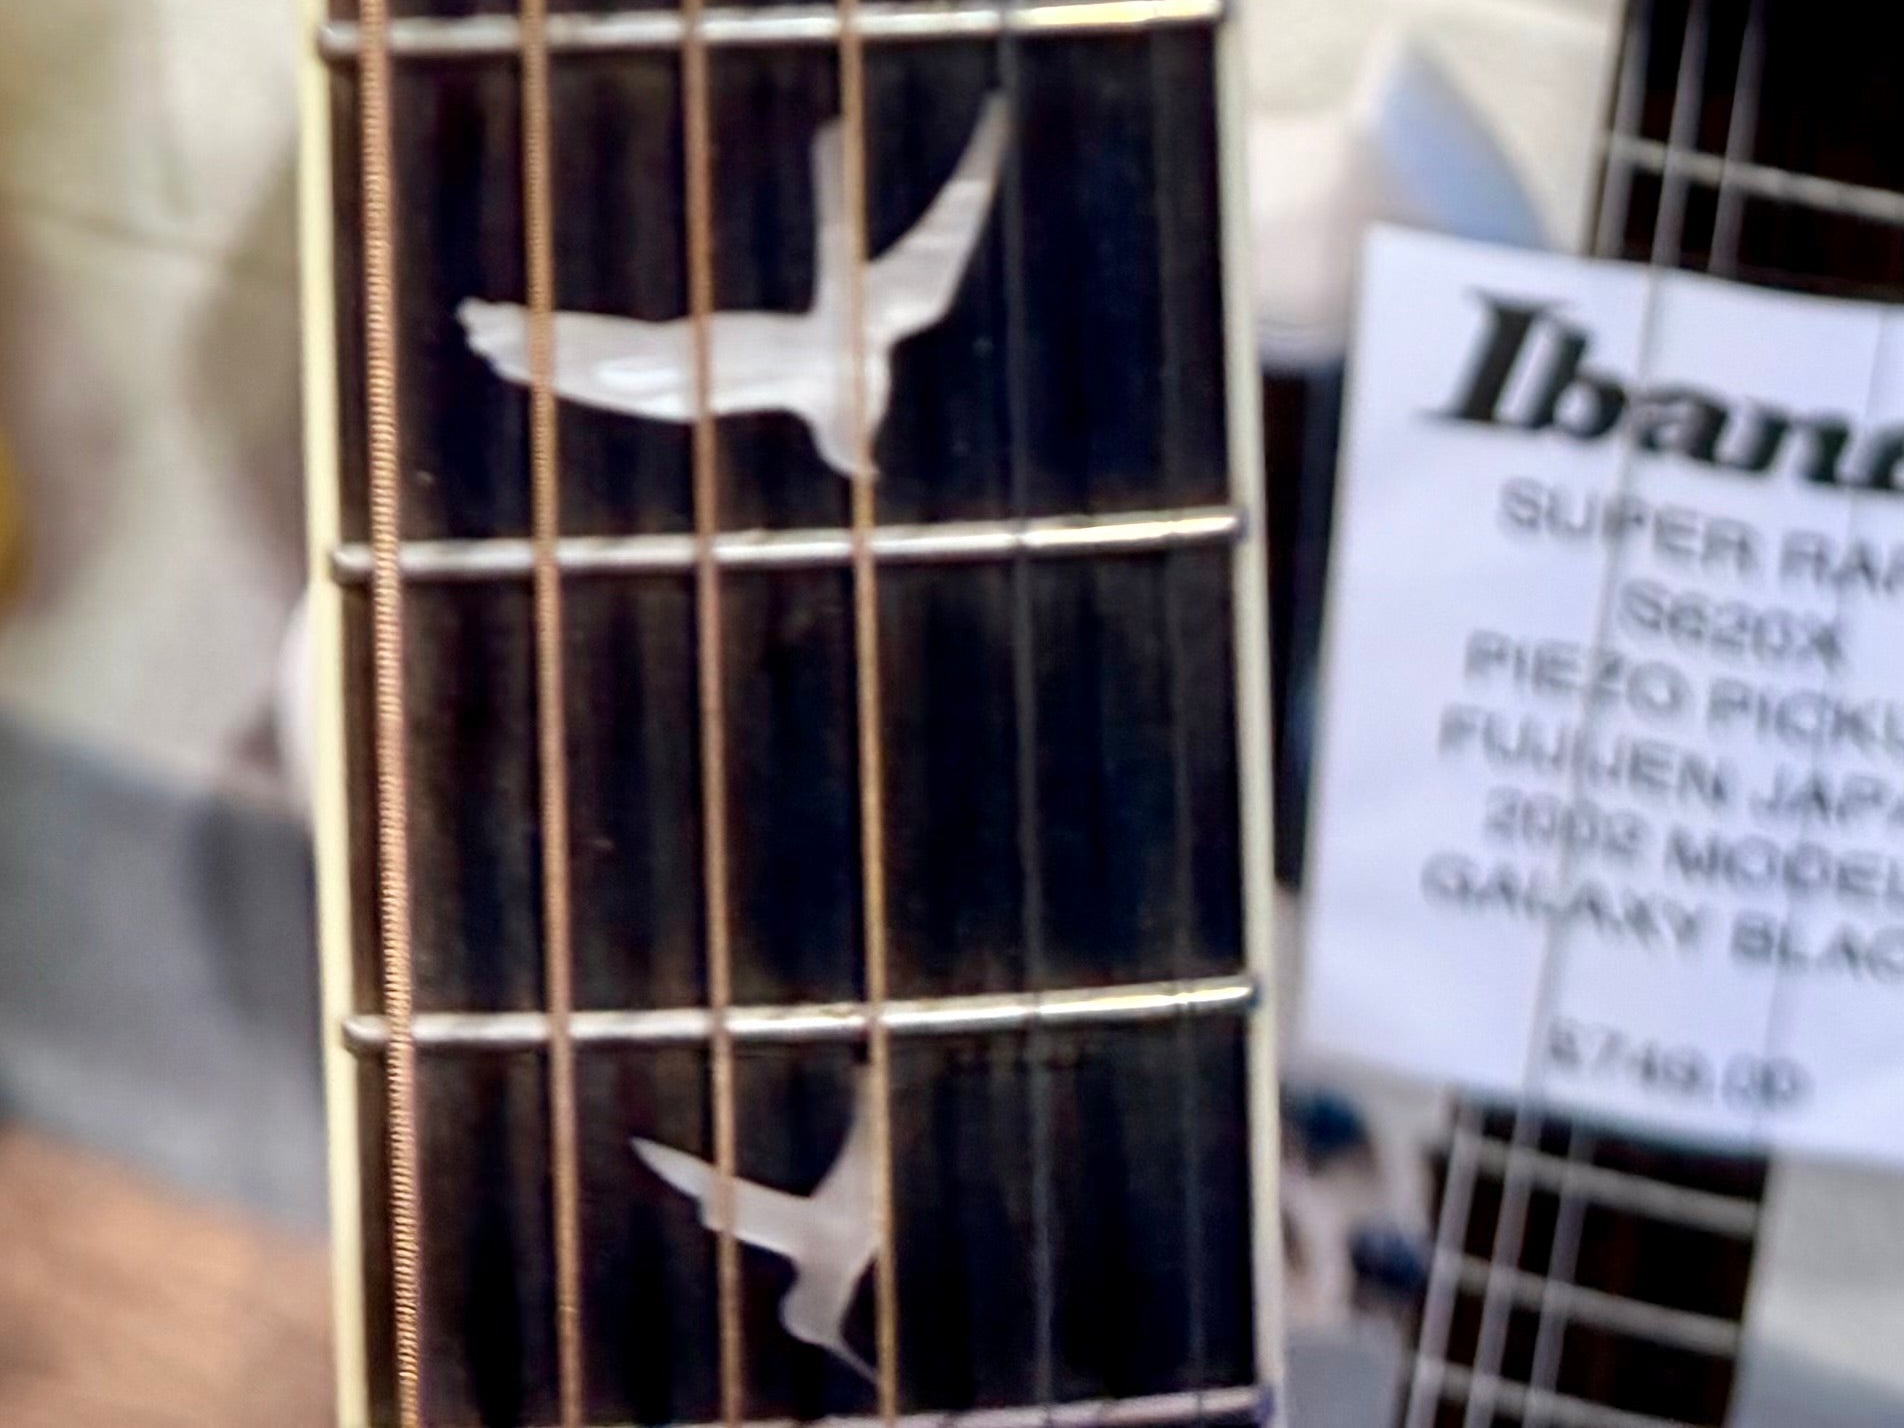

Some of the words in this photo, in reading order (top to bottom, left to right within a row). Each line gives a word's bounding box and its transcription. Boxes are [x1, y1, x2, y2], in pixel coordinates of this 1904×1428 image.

[1498, 475, 1762, 571] SUPER
[1461, 626, 1698, 719] PIEZO
[1418, 849, 1707, 952] GALAXY
